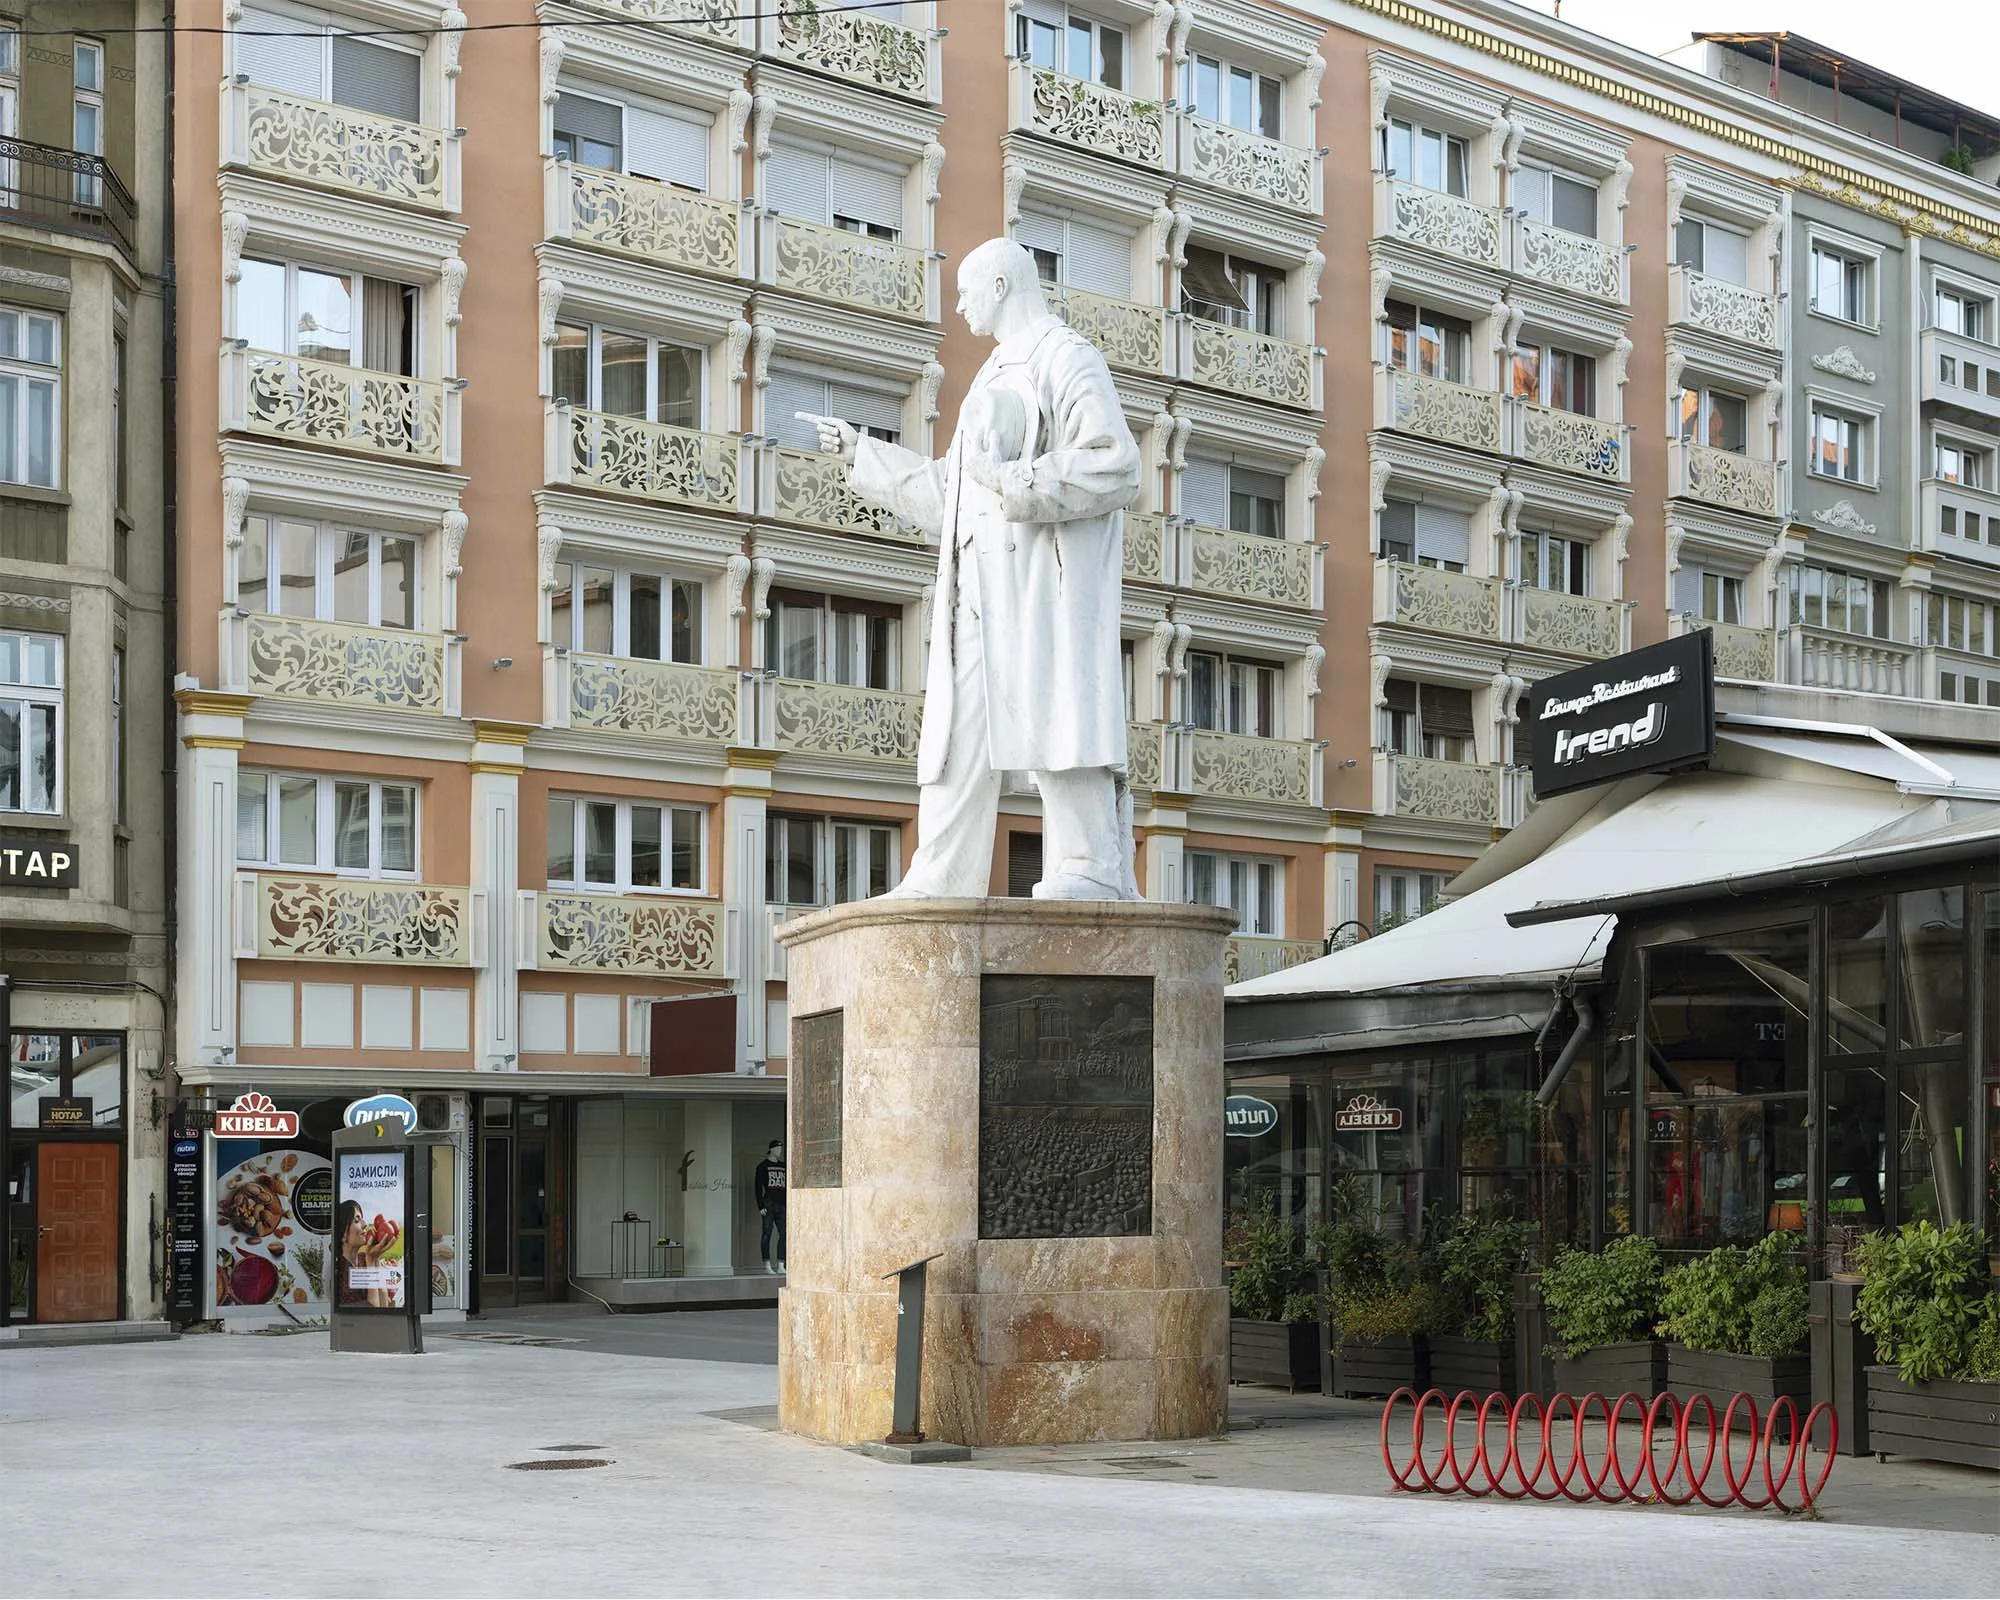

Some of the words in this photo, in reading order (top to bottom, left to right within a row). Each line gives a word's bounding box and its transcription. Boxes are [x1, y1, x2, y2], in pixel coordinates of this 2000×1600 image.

[1539, 695, 1593, 720] Lounge
[1592, 665, 1679, 703] Restaurant
[1554, 702, 1664, 764] trend
[0, 848, 71, 878] ТАР
[51, 1111, 83, 1120] НОТАР
[220, 1117, 290, 1132] KIBELA
[354, 1107, 410, 1126] nuti
[348, 1165, 398, 1179] ЗАМИСЛИ
[374, 1180, 397, 1188] ЗАЕДНО
[164, 1217, 174, 1295] НОТАР
